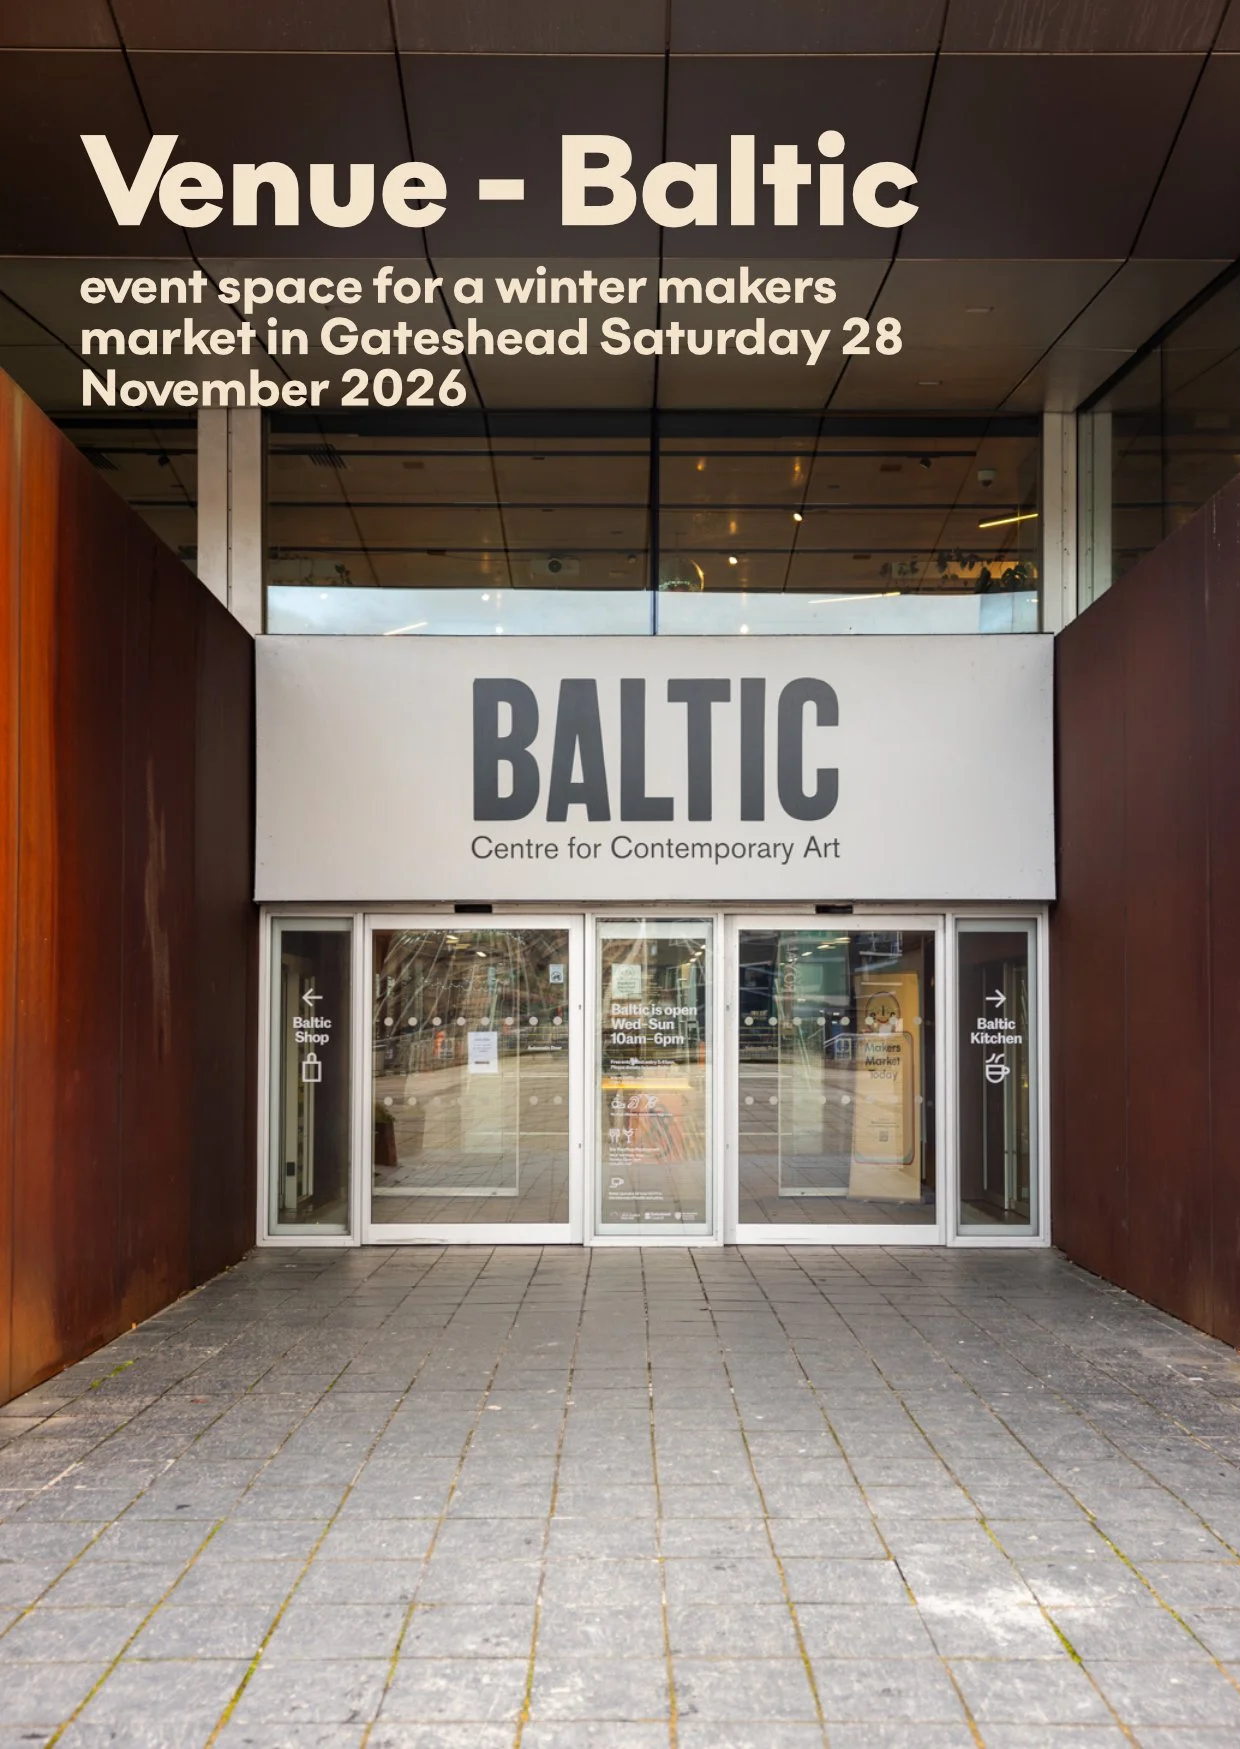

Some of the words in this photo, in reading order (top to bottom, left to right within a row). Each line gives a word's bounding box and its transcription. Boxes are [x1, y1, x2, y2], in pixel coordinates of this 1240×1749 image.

[473, 677, 839, 821] BALTIC
[471, 835, 559, 860] Centre
[567, 836, 602, 860] for
[610, 835, 795, 866] Contemporary
[803, 836, 841, 859] Art
[611, 1003, 650, 1015] Baltic
[652, 1004, 662, 1015] is
[665, 1006, 697, 1018] open
[293, 1016, 332, 1029] Baltic
[977, 1017, 1016, 1030] Baltic
[294, 1031, 330, 1045] Shop
[970, 1032, 1023, 1044] Kitchen
[865, 1042, 901, 1053] Makers
[865, 1056, 900, 1067] Market
[868, 1069, 898, 1082] Today
